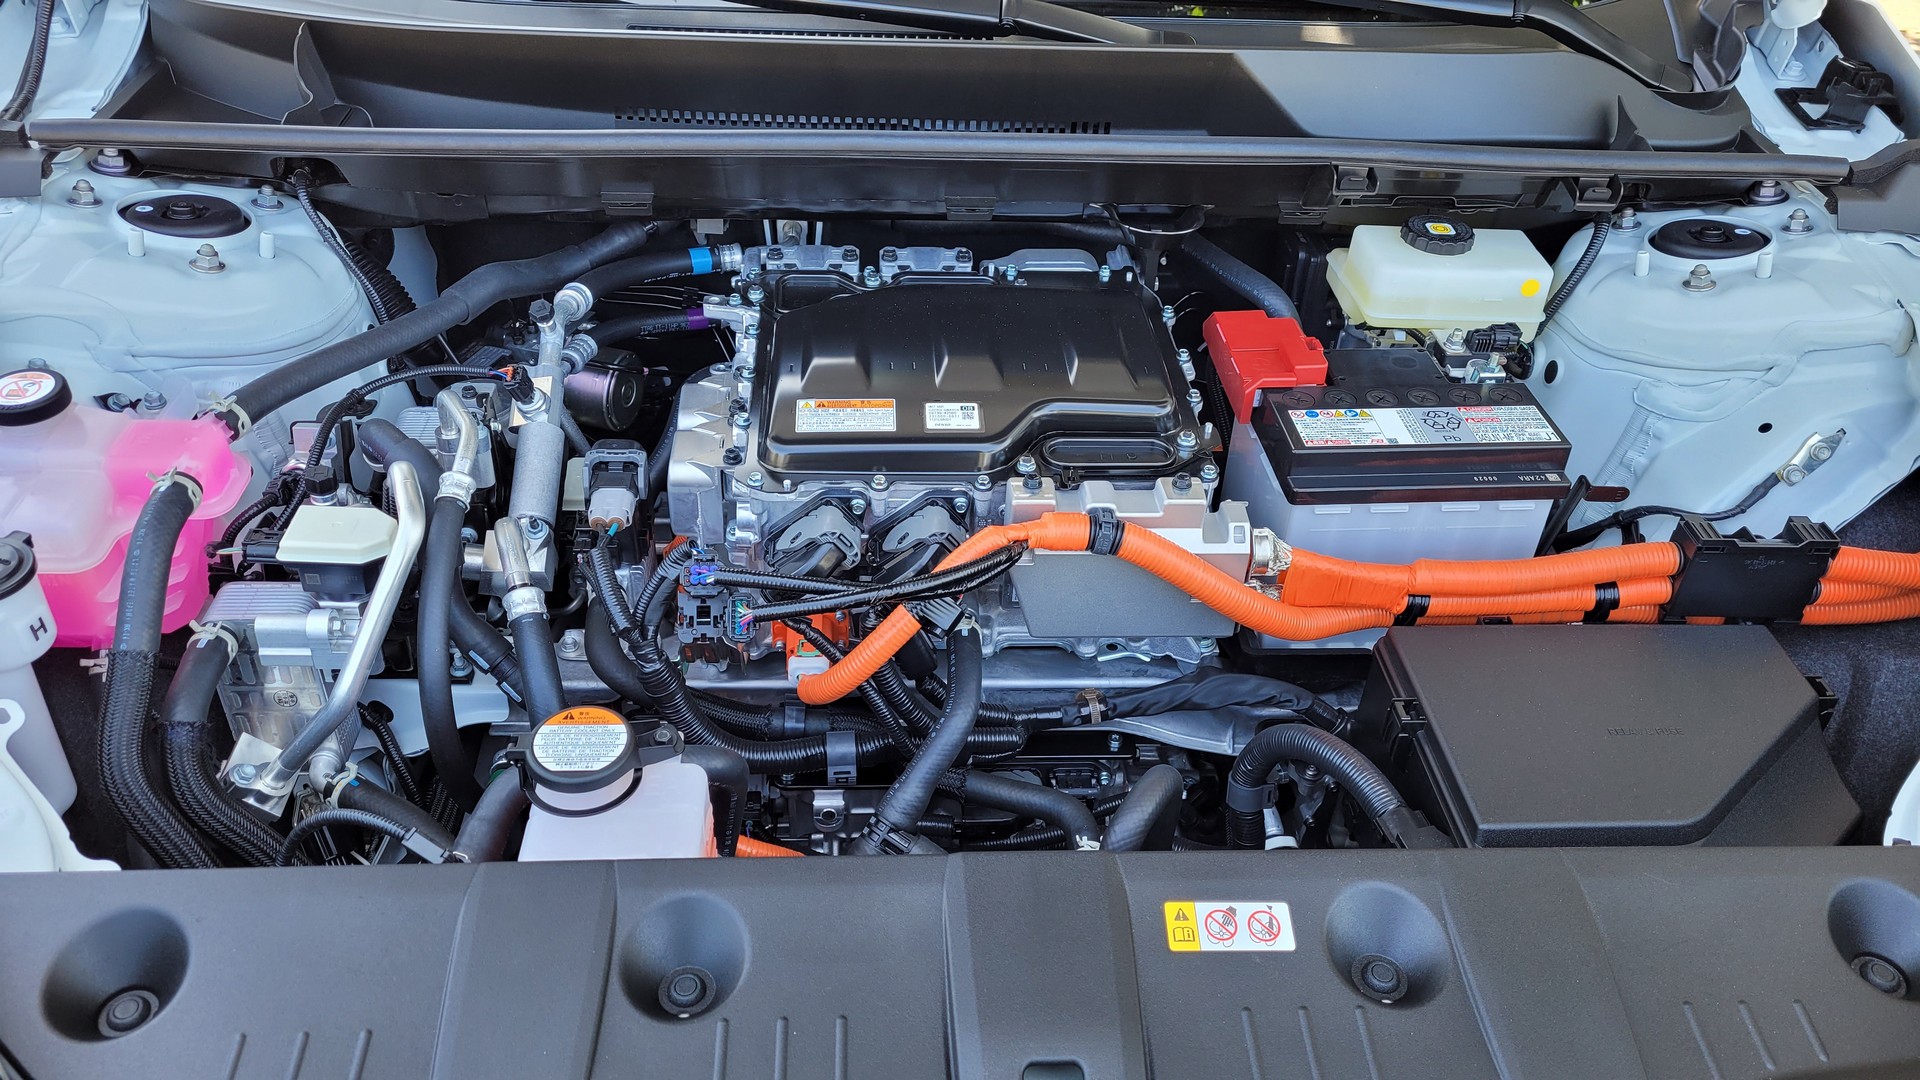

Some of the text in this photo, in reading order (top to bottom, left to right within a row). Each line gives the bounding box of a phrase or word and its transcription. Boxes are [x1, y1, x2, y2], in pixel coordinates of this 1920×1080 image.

[29, 616, 48, 642] H
[1607, 727, 1642, 736] RELAY
[1655, 727, 1685, 736] FUSE
